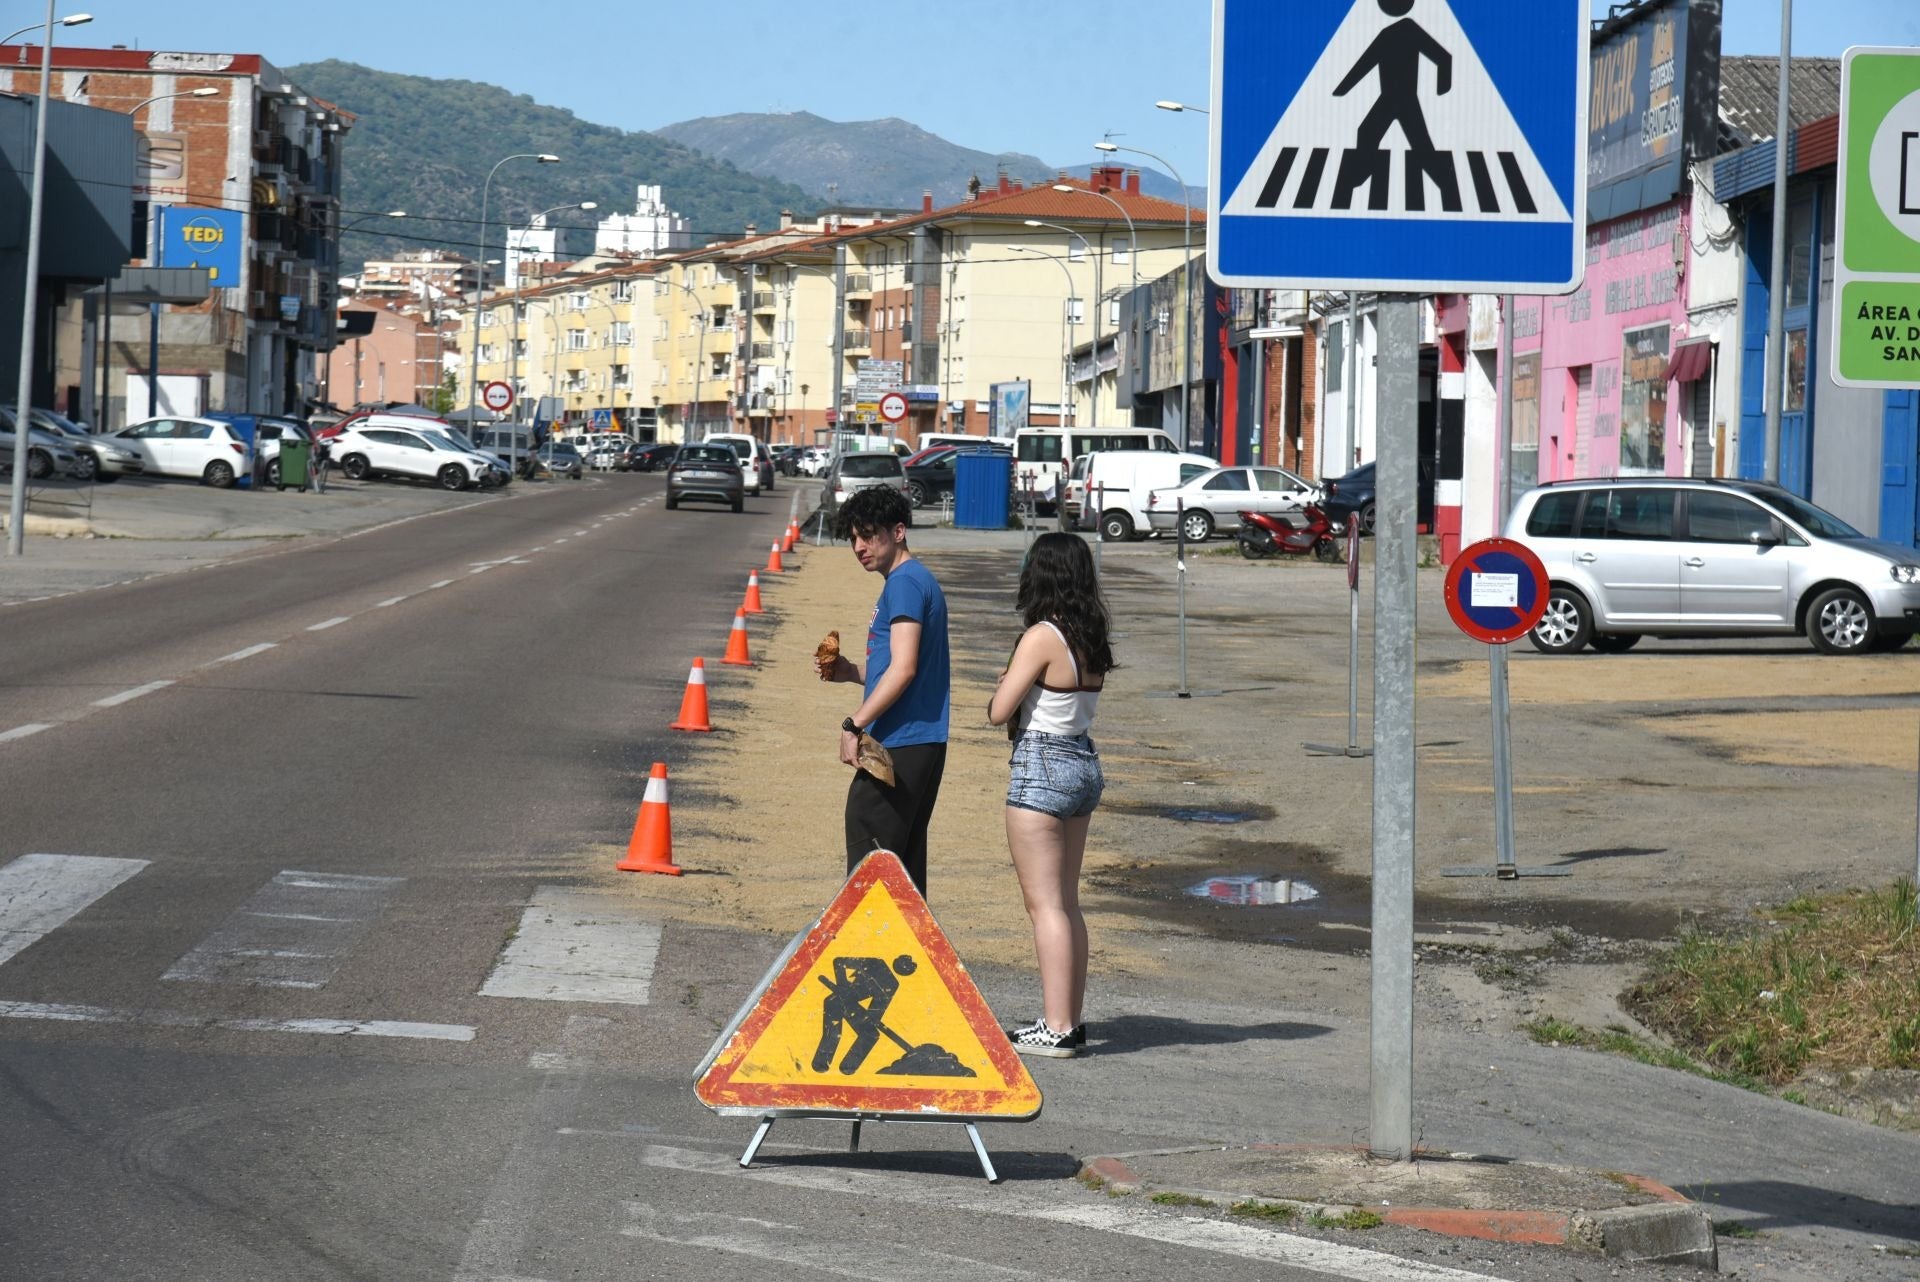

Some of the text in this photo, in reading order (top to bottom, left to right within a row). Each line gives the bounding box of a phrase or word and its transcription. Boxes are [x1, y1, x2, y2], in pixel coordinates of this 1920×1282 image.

[1591, 36, 1638, 132] HOGAR
[131, 184, 188, 196] SEAT
[182, 226, 224, 243] TEDi
[1857, 301, 1911, 321] ÁREA
[1870, 325, 1900, 341] AV.
